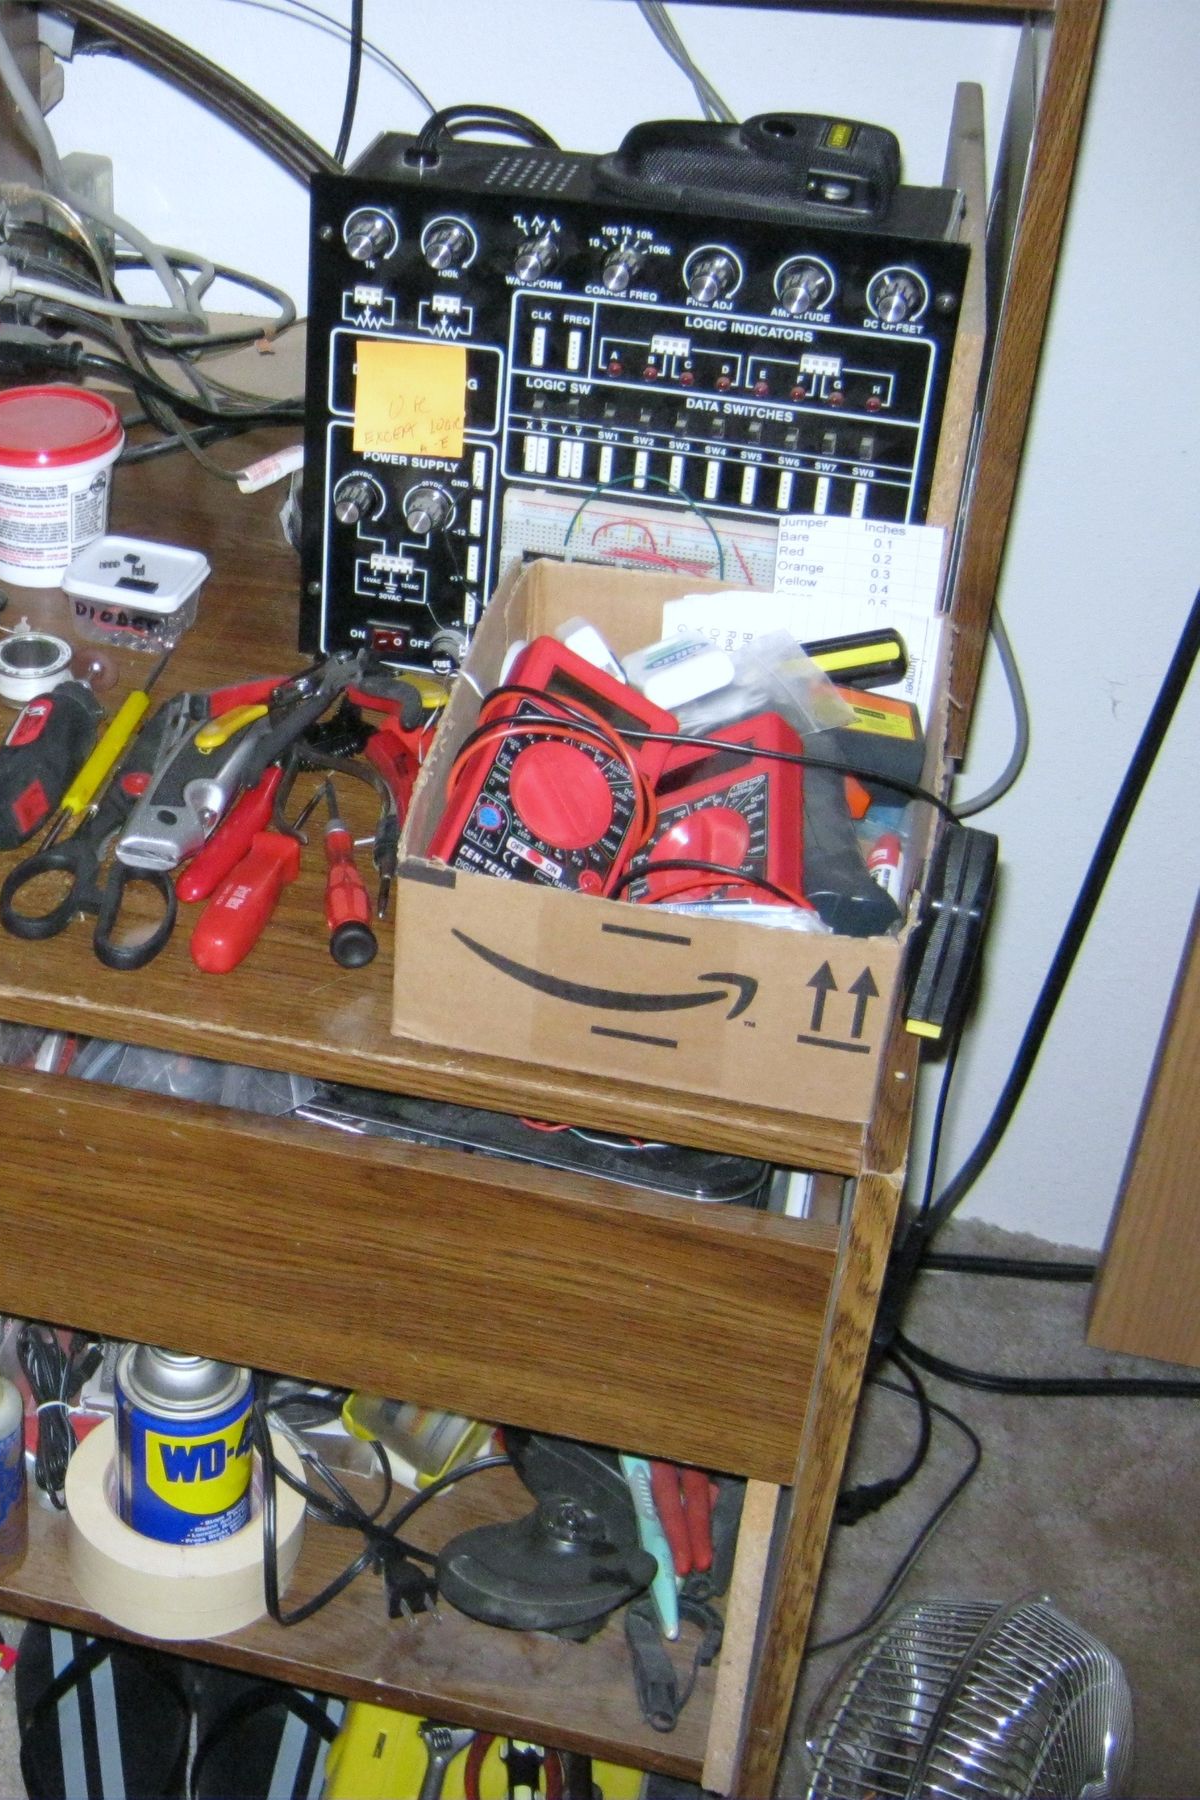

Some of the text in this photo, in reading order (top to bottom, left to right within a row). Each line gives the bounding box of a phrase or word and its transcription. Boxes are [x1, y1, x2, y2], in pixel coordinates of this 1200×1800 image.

[588, 225, 671, 256] 10 100 1k 10k 100k
[629, 290, 658, 303] FREQ
[711, 299, 733, 311] ADJ
[531, 310, 552, 321] CLK
[563, 313, 591, 327] FREQ
[684, 316, 814, 343] LOGIC INDICATORS
[863, 318, 878, 330] DC
[609, 351, 619, 360] A
[647, 355, 655, 364] B
[684, 360, 693, 369] C
[721, 365, 730, 374] D
[759, 370, 767, 379] E
[796, 375, 804, 384] F
[526, 377, 591, 395] LOGIC SW
[833, 380, 842, 390] G
[872, 385, 881, 395] H
[686, 398, 794, 423] DATA SWITCHES
[598, 431, 619, 441] SW1
[633, 436, 655, 447] SW2
[668, 440, 691, 452] SW3
[704, 445, 727, 457] SW4
[362, 451, 460, 473] POWER SUPPLY
[740, 450, 763, 463] SW5
[778, 456, 800, 467] SW6
[814, 461, 838, 473] SW7
[852, 467, 875, 479] SW8
[451, 479, 469, 489] GND
[780, 516, 906, 536] Jumper Inches
[780, 531, 893, 549] Bare 0.1
[779, 546, 892, 565] Red 0.2
[777, 560, 890, 580] Orange 0.3
[776, 575, 889, 595] Yellow 0.4
[378, 592, 402, 602] 30VAC
[350, 629, 431, 649] ON OFF
[432, 660, 452, 668] FUSE
[909, 654, 920, 696] Jumper
[510, 838, 526, 853] OFF
[544, 861, 560, 876] ON
